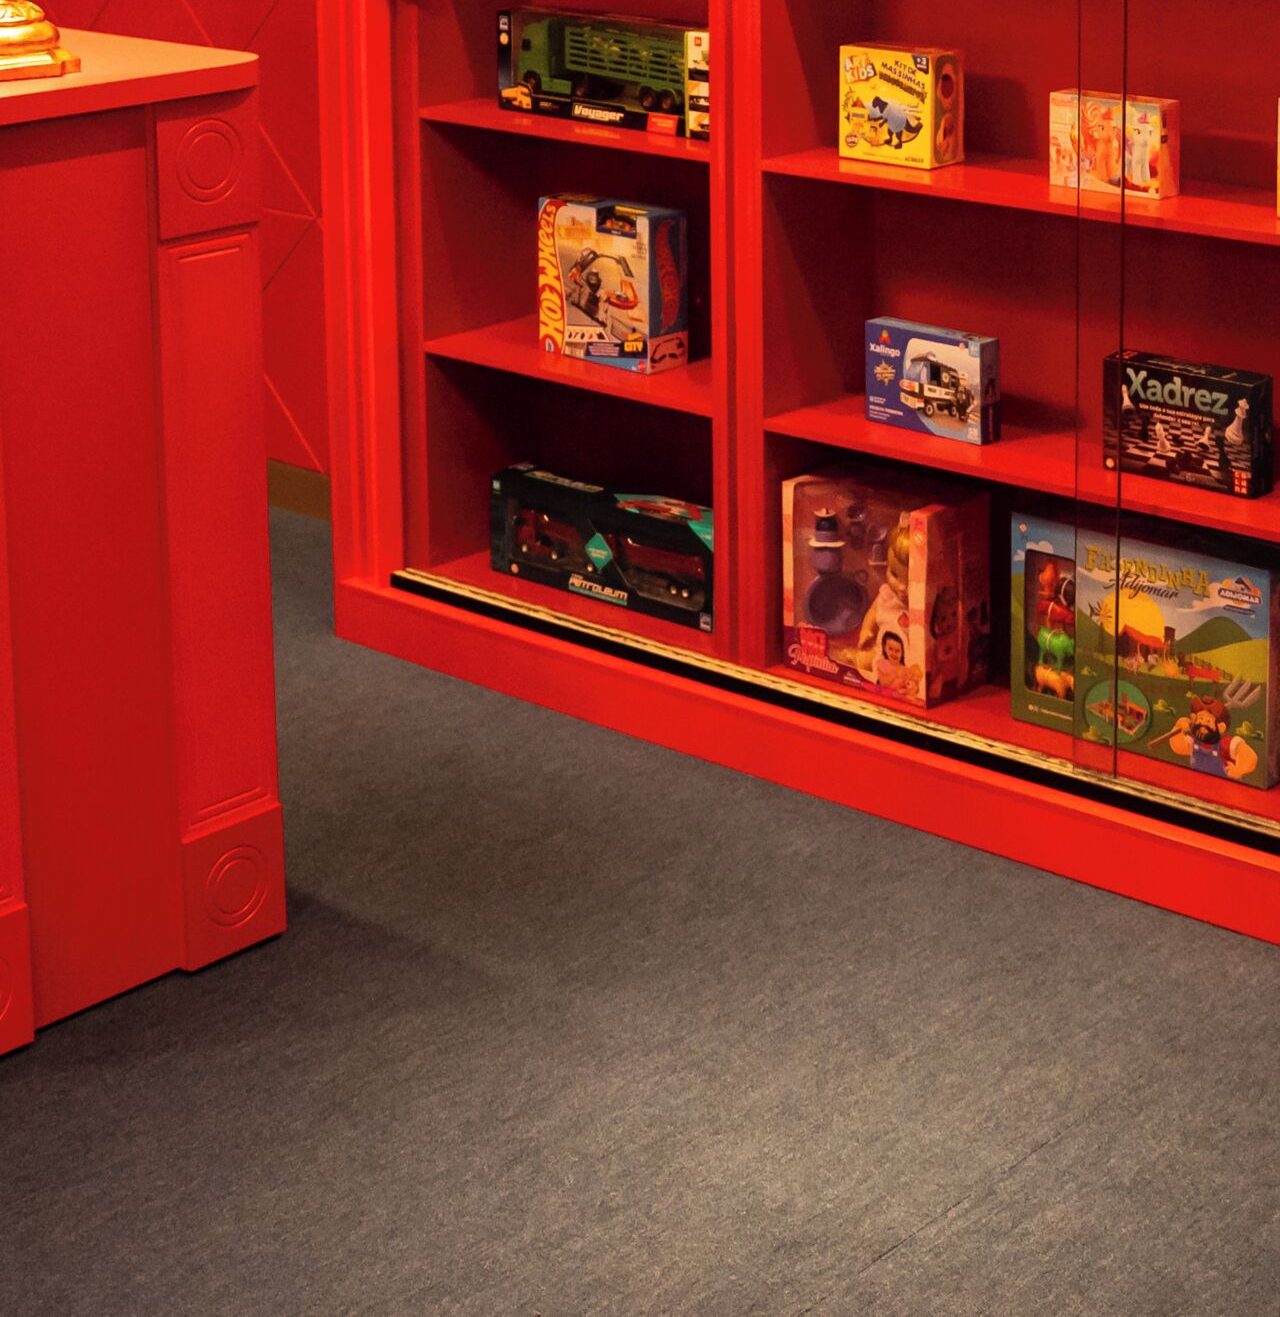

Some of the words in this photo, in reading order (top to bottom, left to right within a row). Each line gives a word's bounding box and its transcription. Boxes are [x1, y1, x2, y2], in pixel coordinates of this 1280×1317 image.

[573, 104, 625, 122] Voyager
[869, 342, 901, 358] Xalingo
[1125, 367, 1229, 416] Xadrez
[1103, 571, 1180, 599] Adijomar
